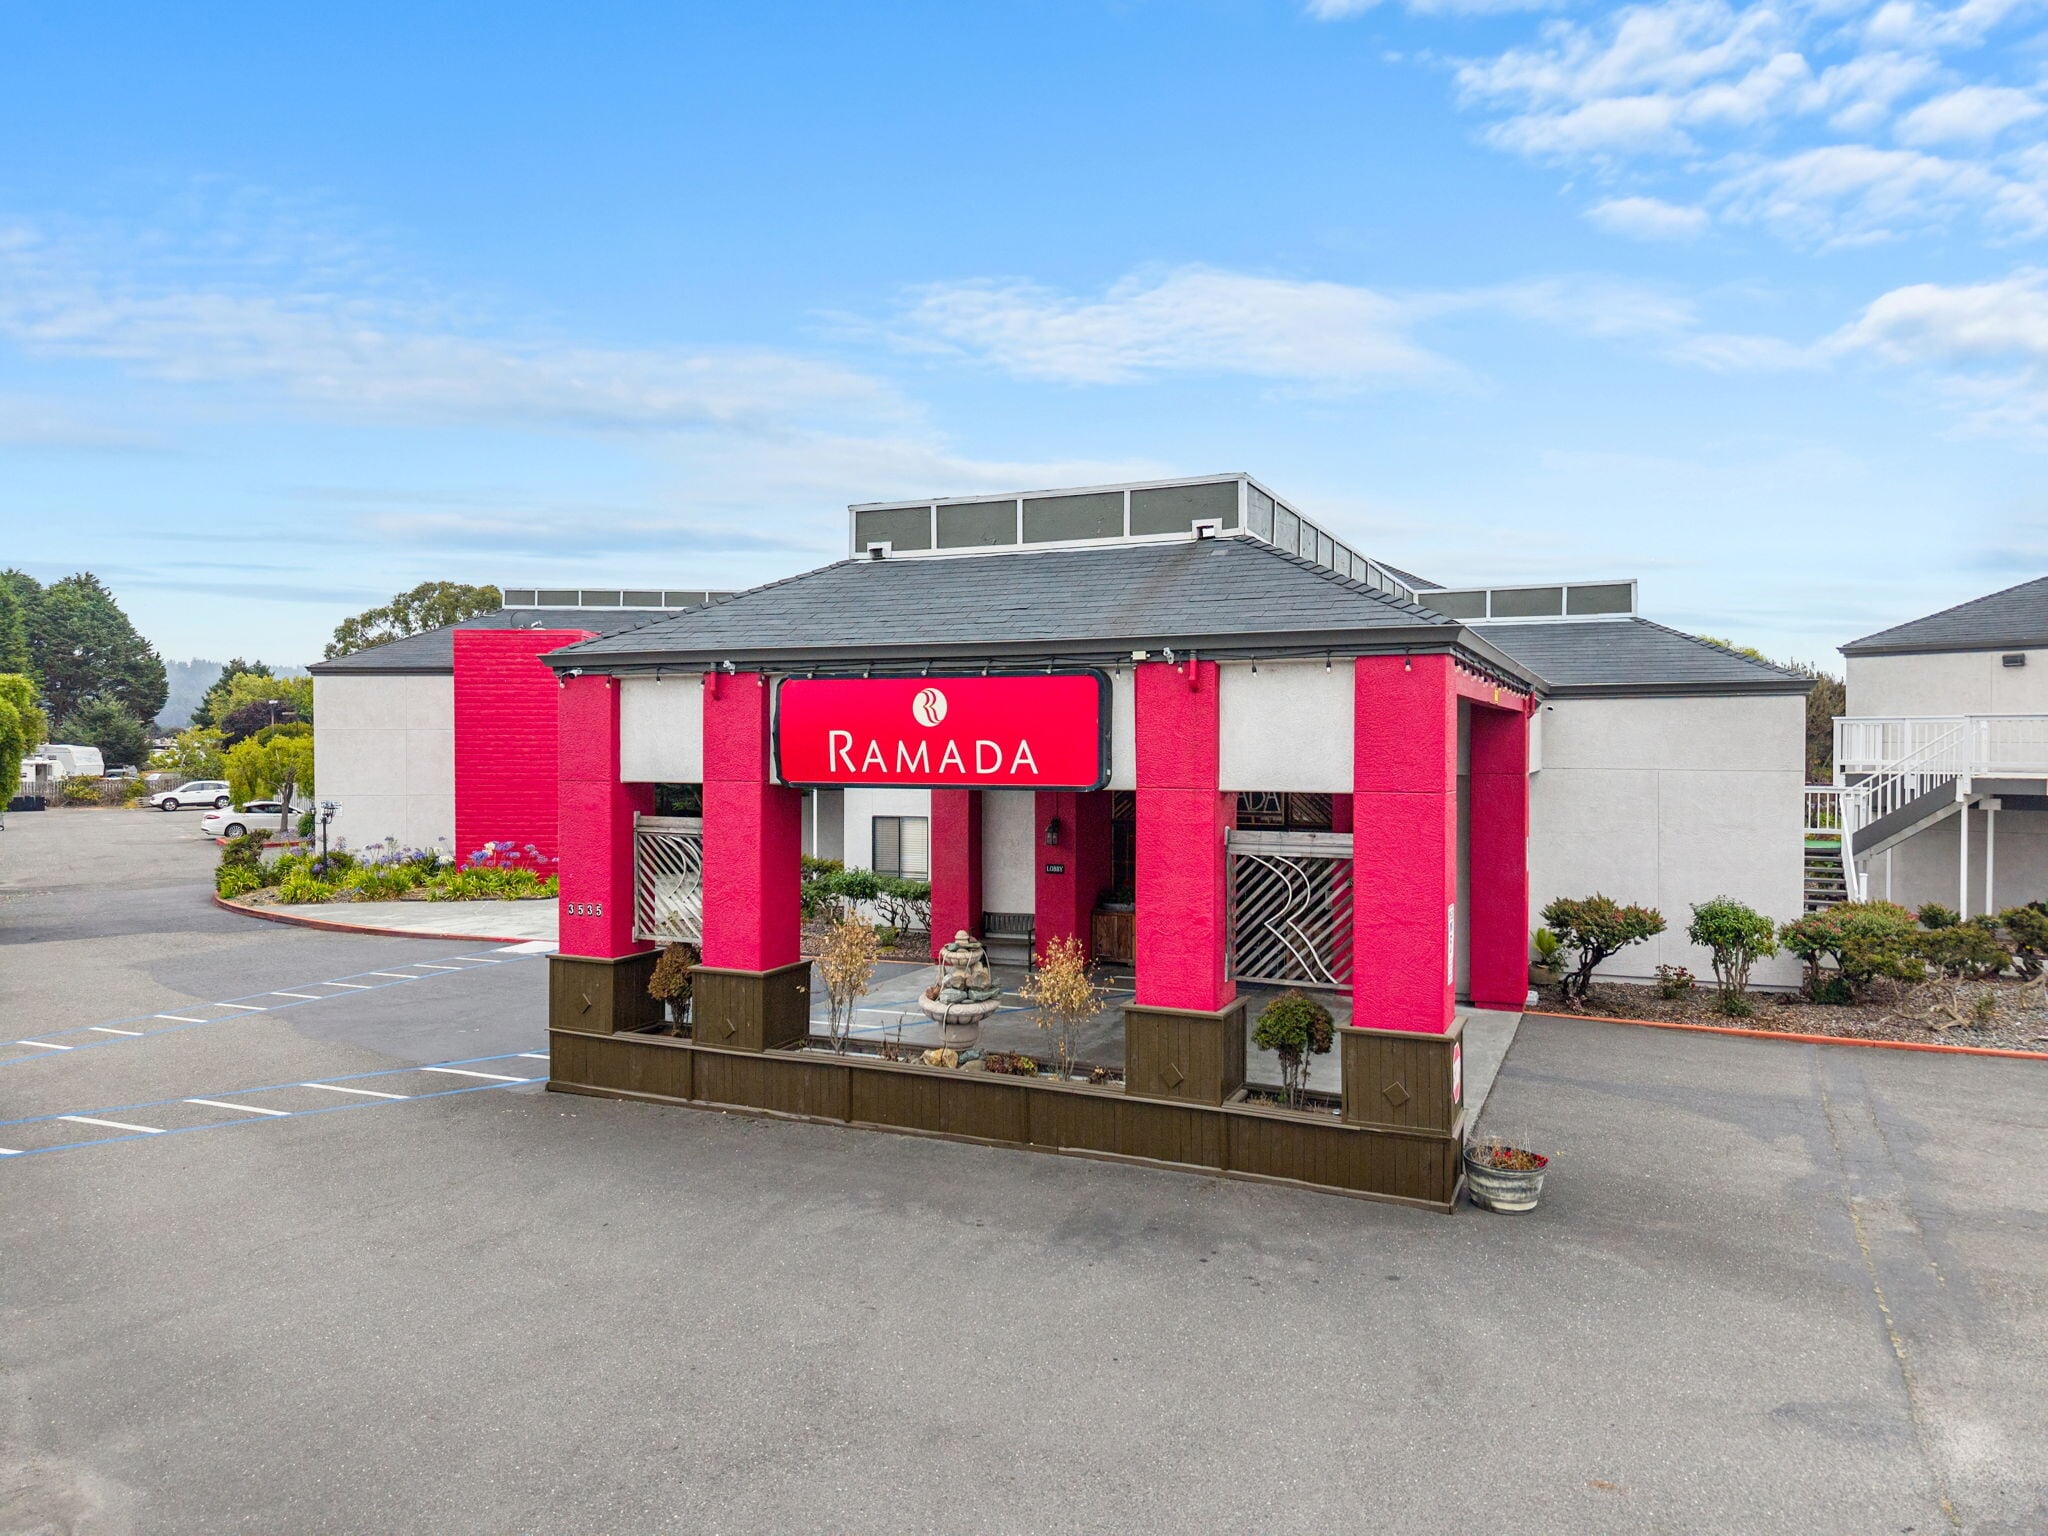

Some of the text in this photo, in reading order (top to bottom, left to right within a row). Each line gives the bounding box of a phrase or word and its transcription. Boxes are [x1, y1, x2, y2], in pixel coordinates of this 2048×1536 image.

[828, 730, 1039, 774] RAMADA
[1046, 865, 1064, 873] LOBBY
[568, 903, 603, 917] 3535
